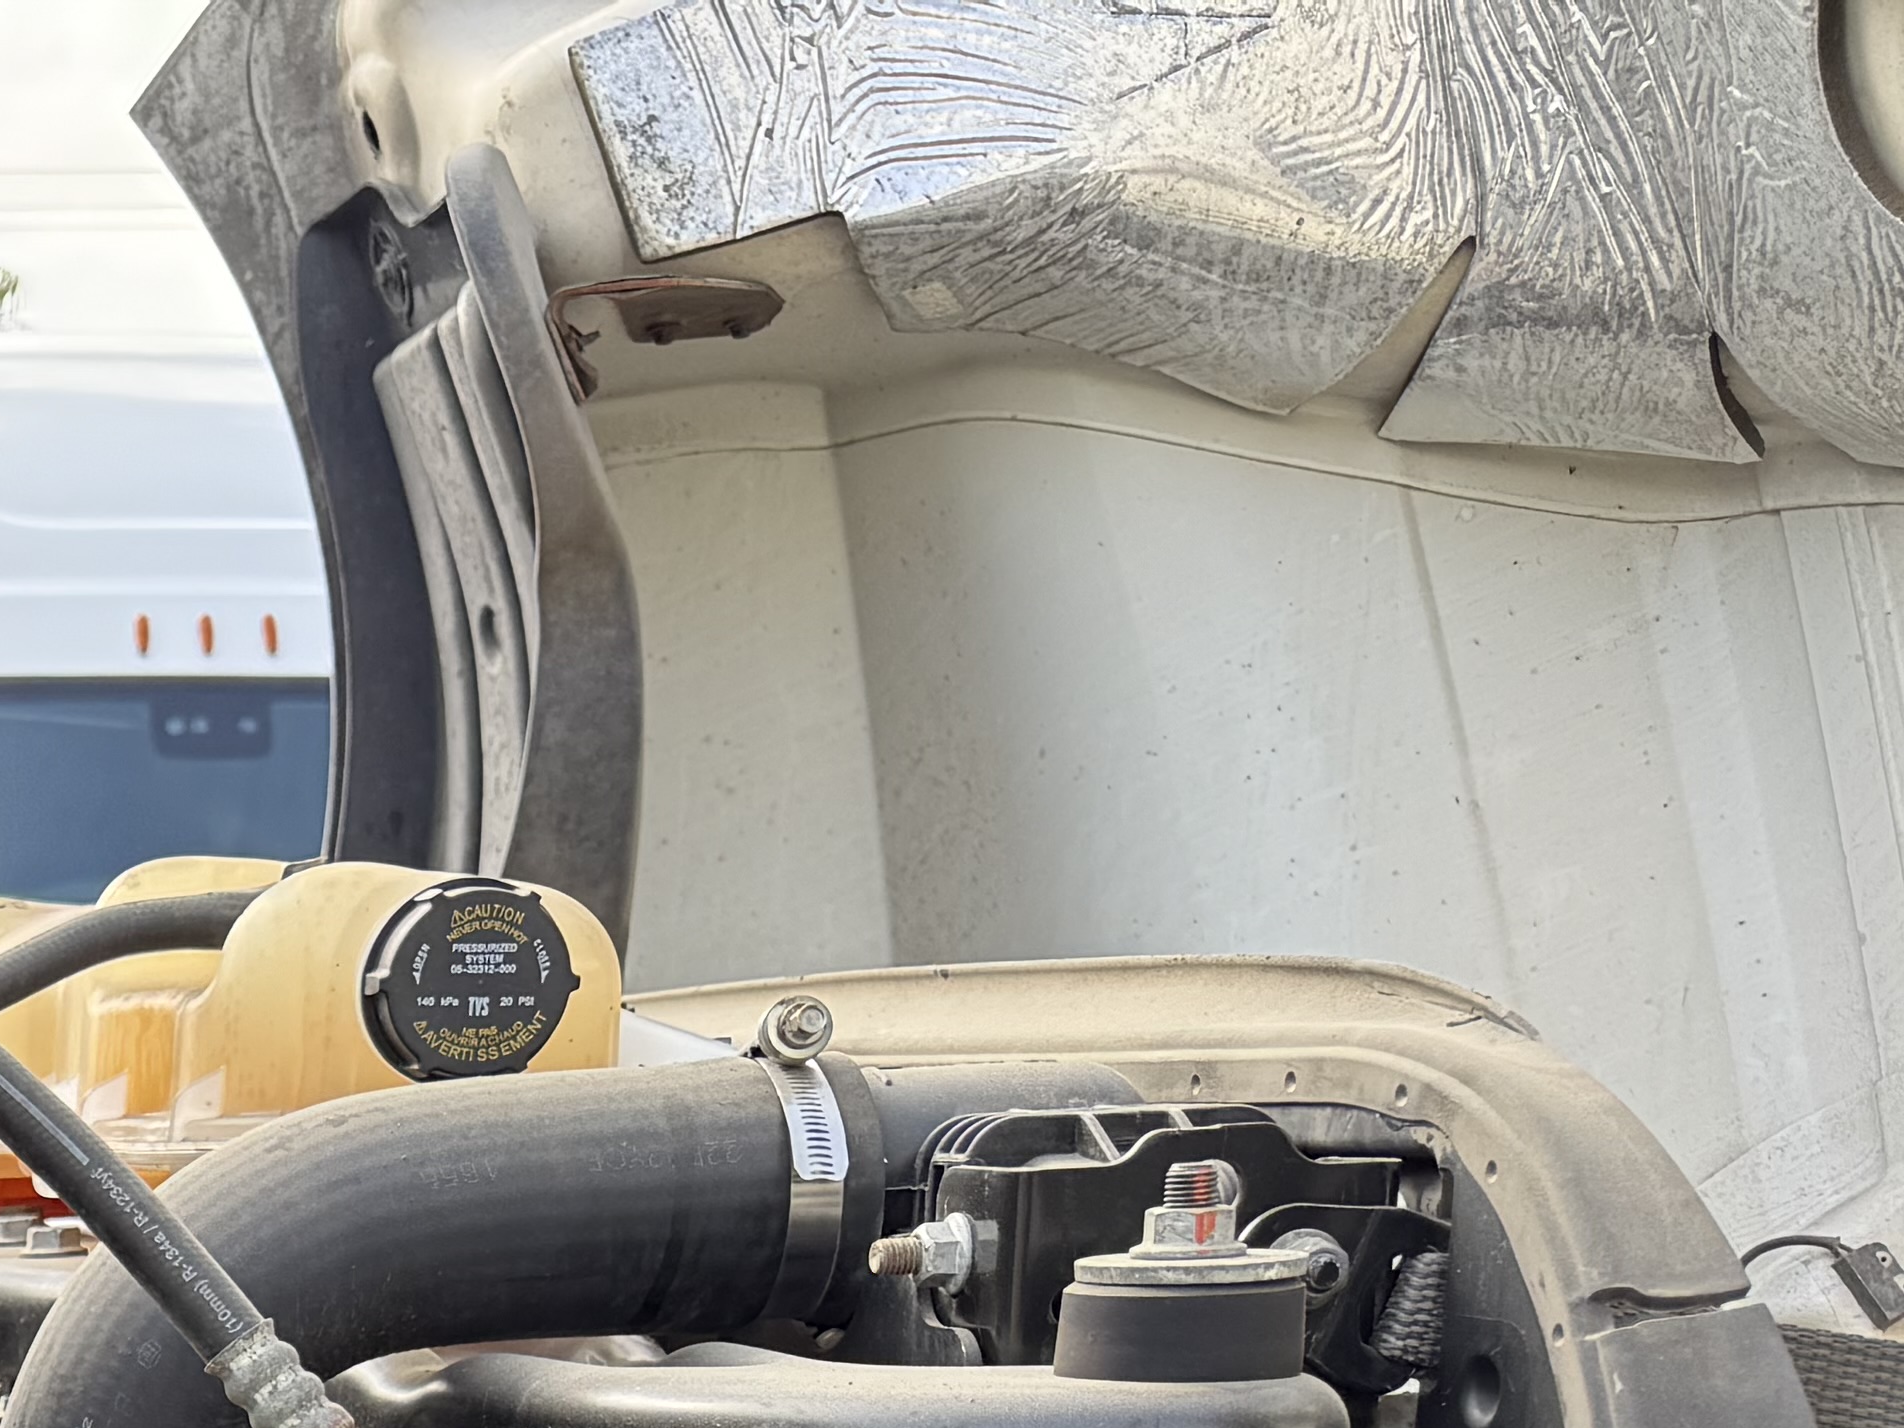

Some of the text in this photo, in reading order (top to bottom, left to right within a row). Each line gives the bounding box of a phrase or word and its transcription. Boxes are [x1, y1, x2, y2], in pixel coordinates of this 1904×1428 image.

[465, 904, 525, 925] CAUTION
[446, 921, 482, 943] NEVER
[452, 943, 518, 952] PRESSURIZED
[465, 954, 504, 964] SYSTEM
[500, 997, 535, 1006] 20 PSI
[153, 1231, 198, 1283] R-134a
[193, 1279, 244, 1334] (10mm)
